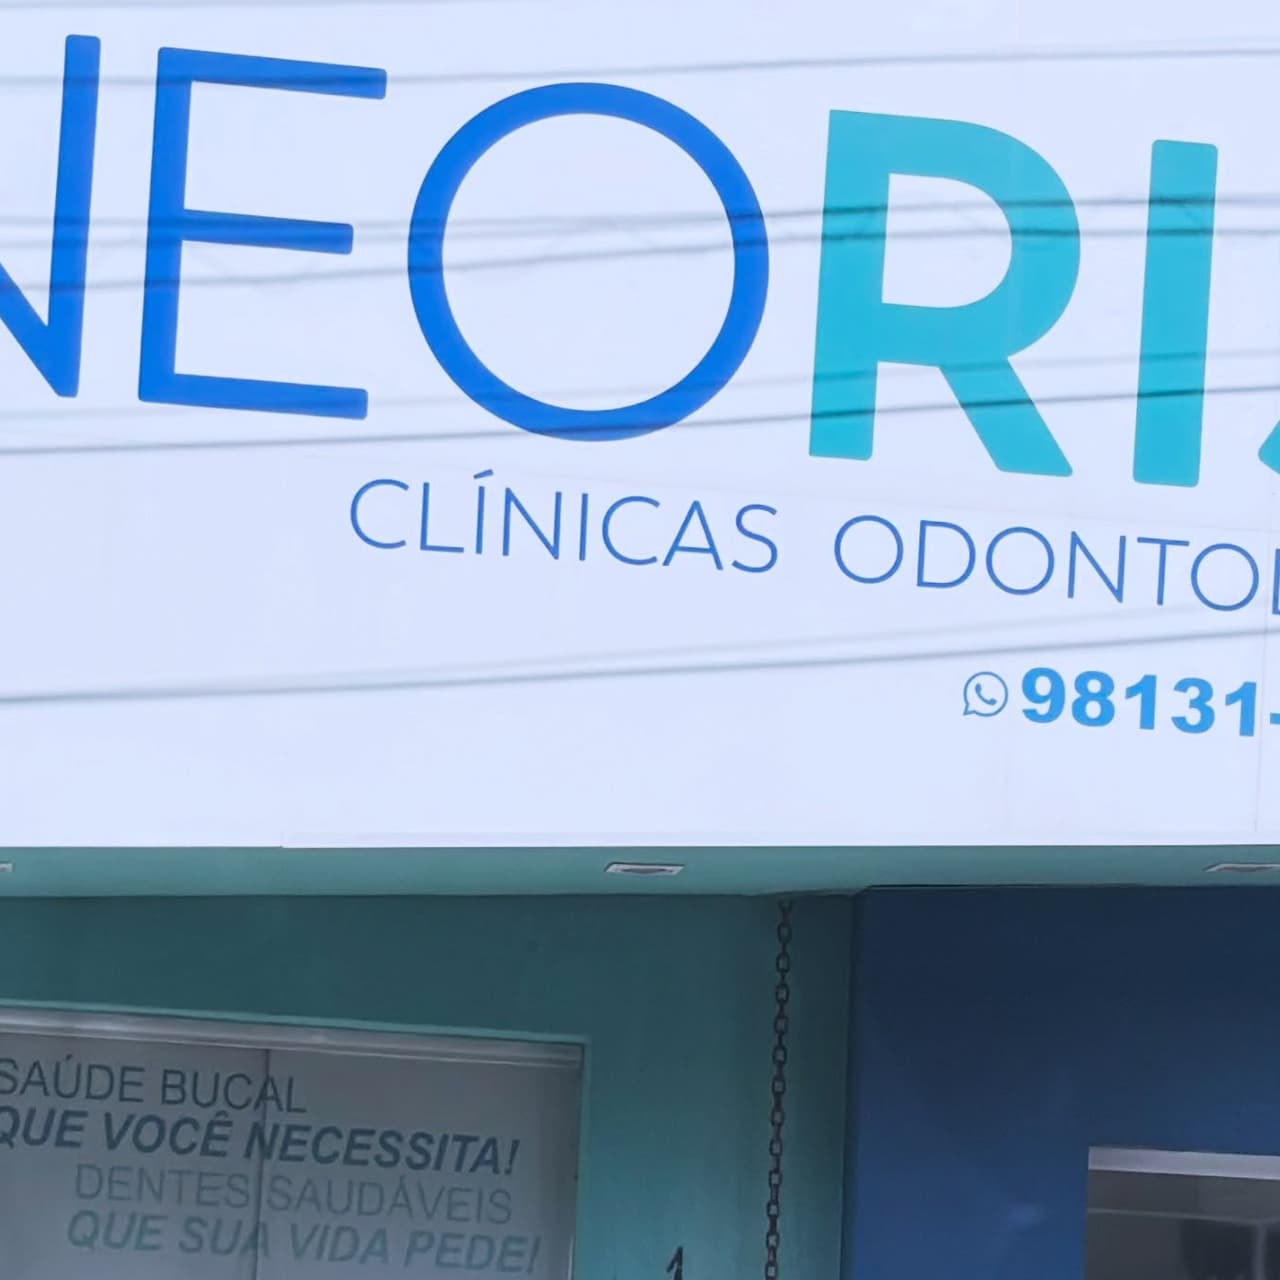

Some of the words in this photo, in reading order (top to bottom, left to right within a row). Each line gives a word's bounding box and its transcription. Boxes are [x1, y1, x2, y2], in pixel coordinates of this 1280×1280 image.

[348, 468, 778, 574] CLÍNICAS
[160, 1068, 308, 1114] BUCAL
[103, 1111, 233, 1159] VOCÊ
[243, 1121, 520, 1176] NECESSITA!
[74, 1163, 251, 1209] DENTES
[265, 1174, 513, 1224] SAUDÁVEIS
[66, 1210, 163, 1250] QUE
[178, 1218, 271, 1258] SUA
[289, 1222, 391, 1266] VIDA
